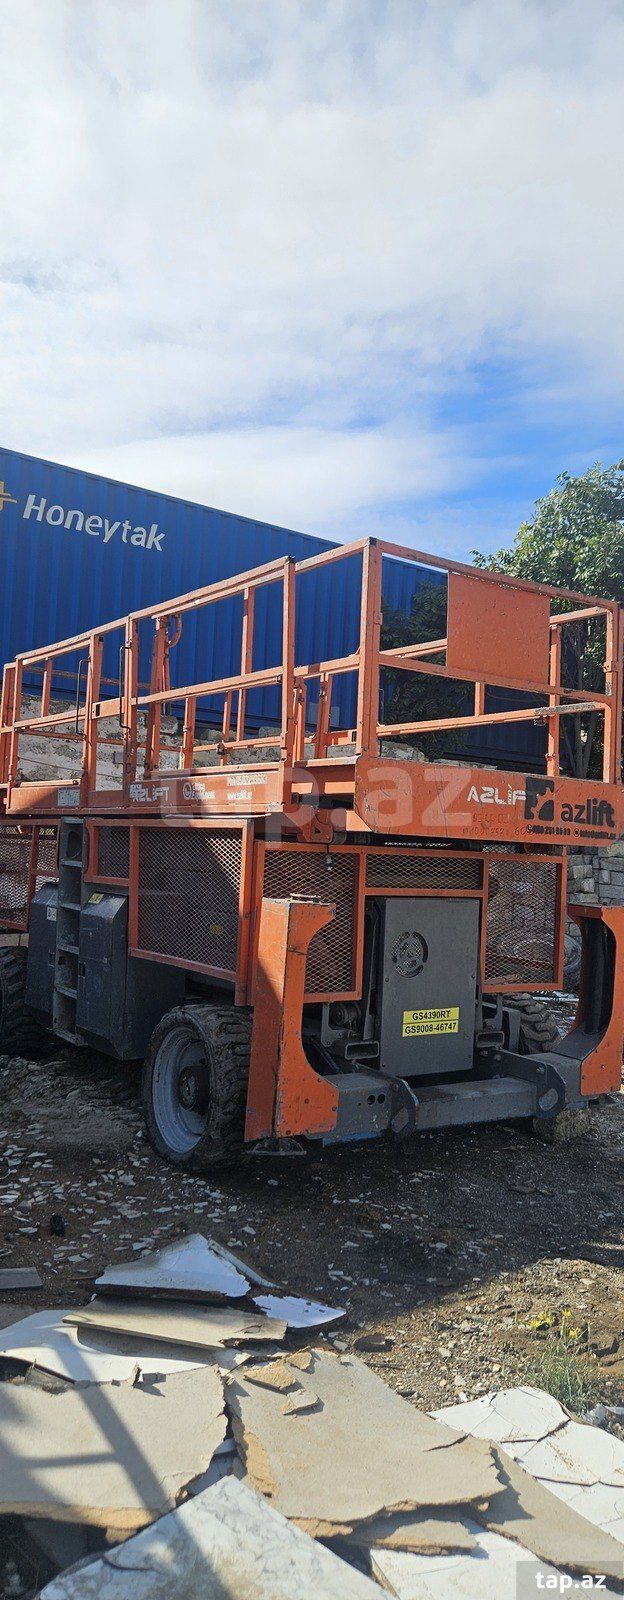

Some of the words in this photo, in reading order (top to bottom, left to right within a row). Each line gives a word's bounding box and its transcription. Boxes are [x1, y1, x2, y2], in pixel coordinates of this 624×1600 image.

[22, 494, 166, 552] Honeytak
[560, 797, 616, 828] azlift
[412, 1010, 451, 1021] GS4390RT
[404, 1022, 457, 1035] GS9008-46747
